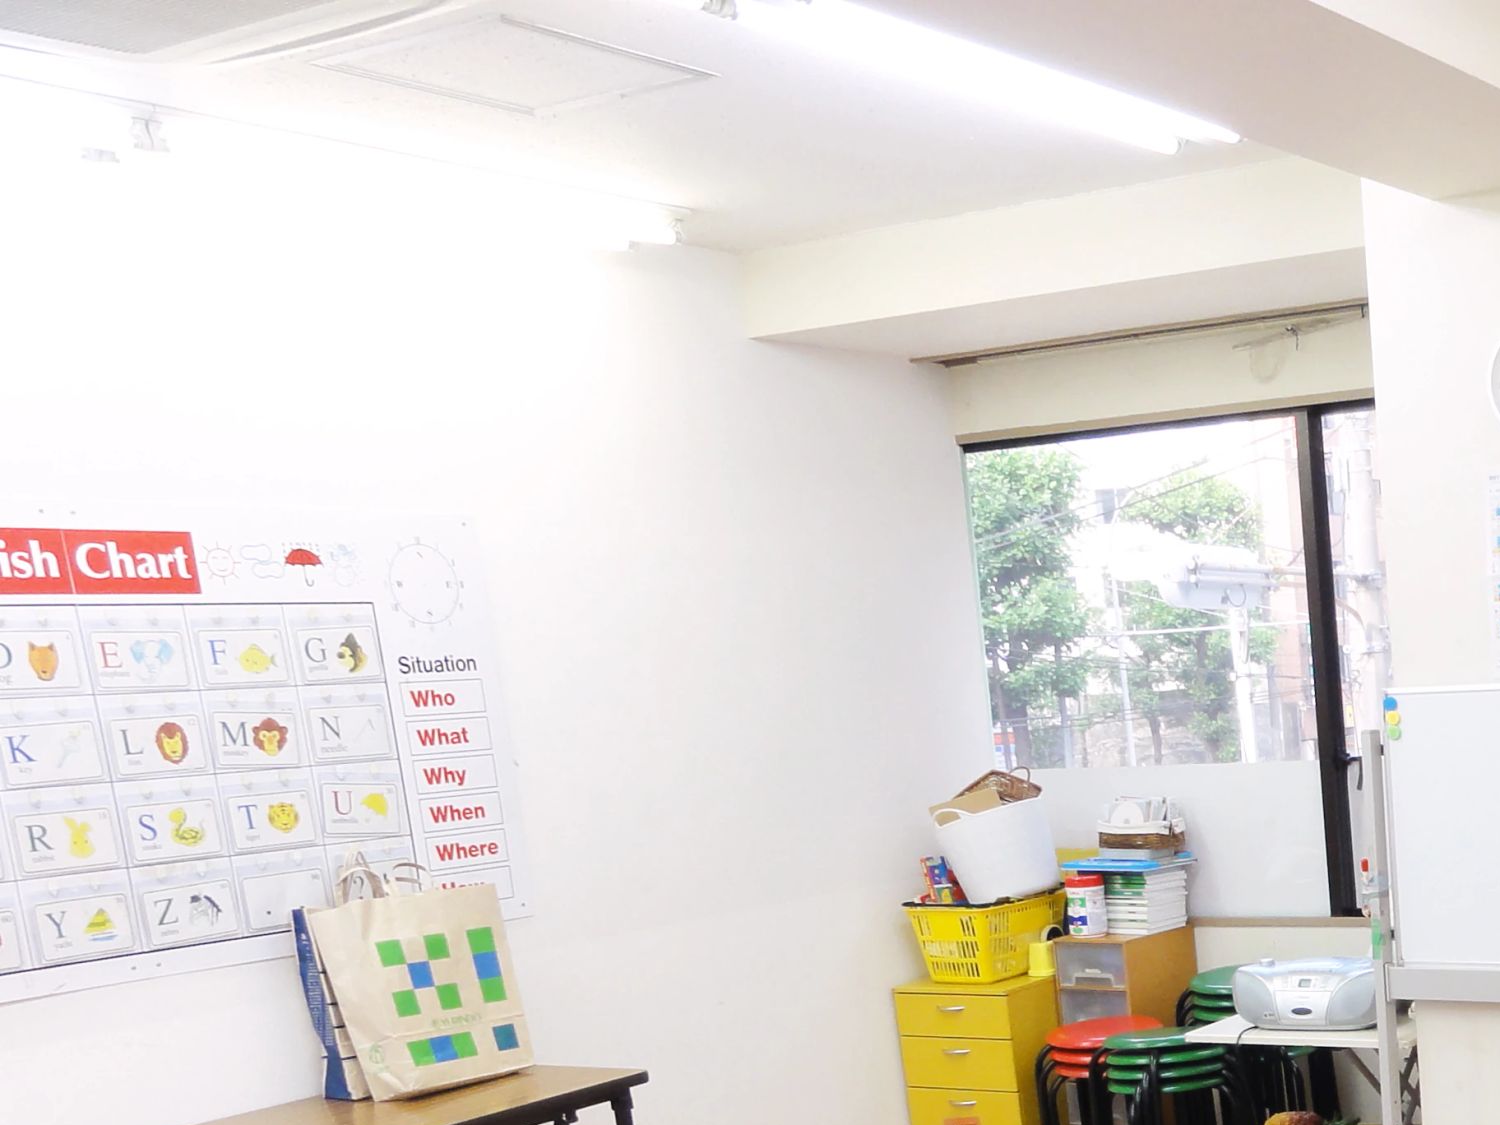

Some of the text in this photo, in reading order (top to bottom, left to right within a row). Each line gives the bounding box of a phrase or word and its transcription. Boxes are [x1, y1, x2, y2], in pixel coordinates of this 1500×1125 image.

[0, 539, 193, 580] ish Chart
[97, 641, 123, 669] E
[208, 639, 227, 666] F
[304, 636, 328, 663] G
[397, 654, 478, 675] Situation
[409, 689, 456, 708] Who
[119, 729, 144, 755] L
[219, 720, 250, 747] M
[319, 715, 342, 742] N
[416, 727, 470, 747] What
[5, 734, 37, 764] K
[422, 765, 467, 787] Why
[331, 790, 353, 816] U
[428, 804, 486, 824] When
[138, 813, 158, 842] S
[237, 804, 258, 830] T
[24, 824, 55, 853] R
[434, 840, 499, 863] Where
[46, 910, 67, 939] Y
[153, 898, 179, 926] Z
